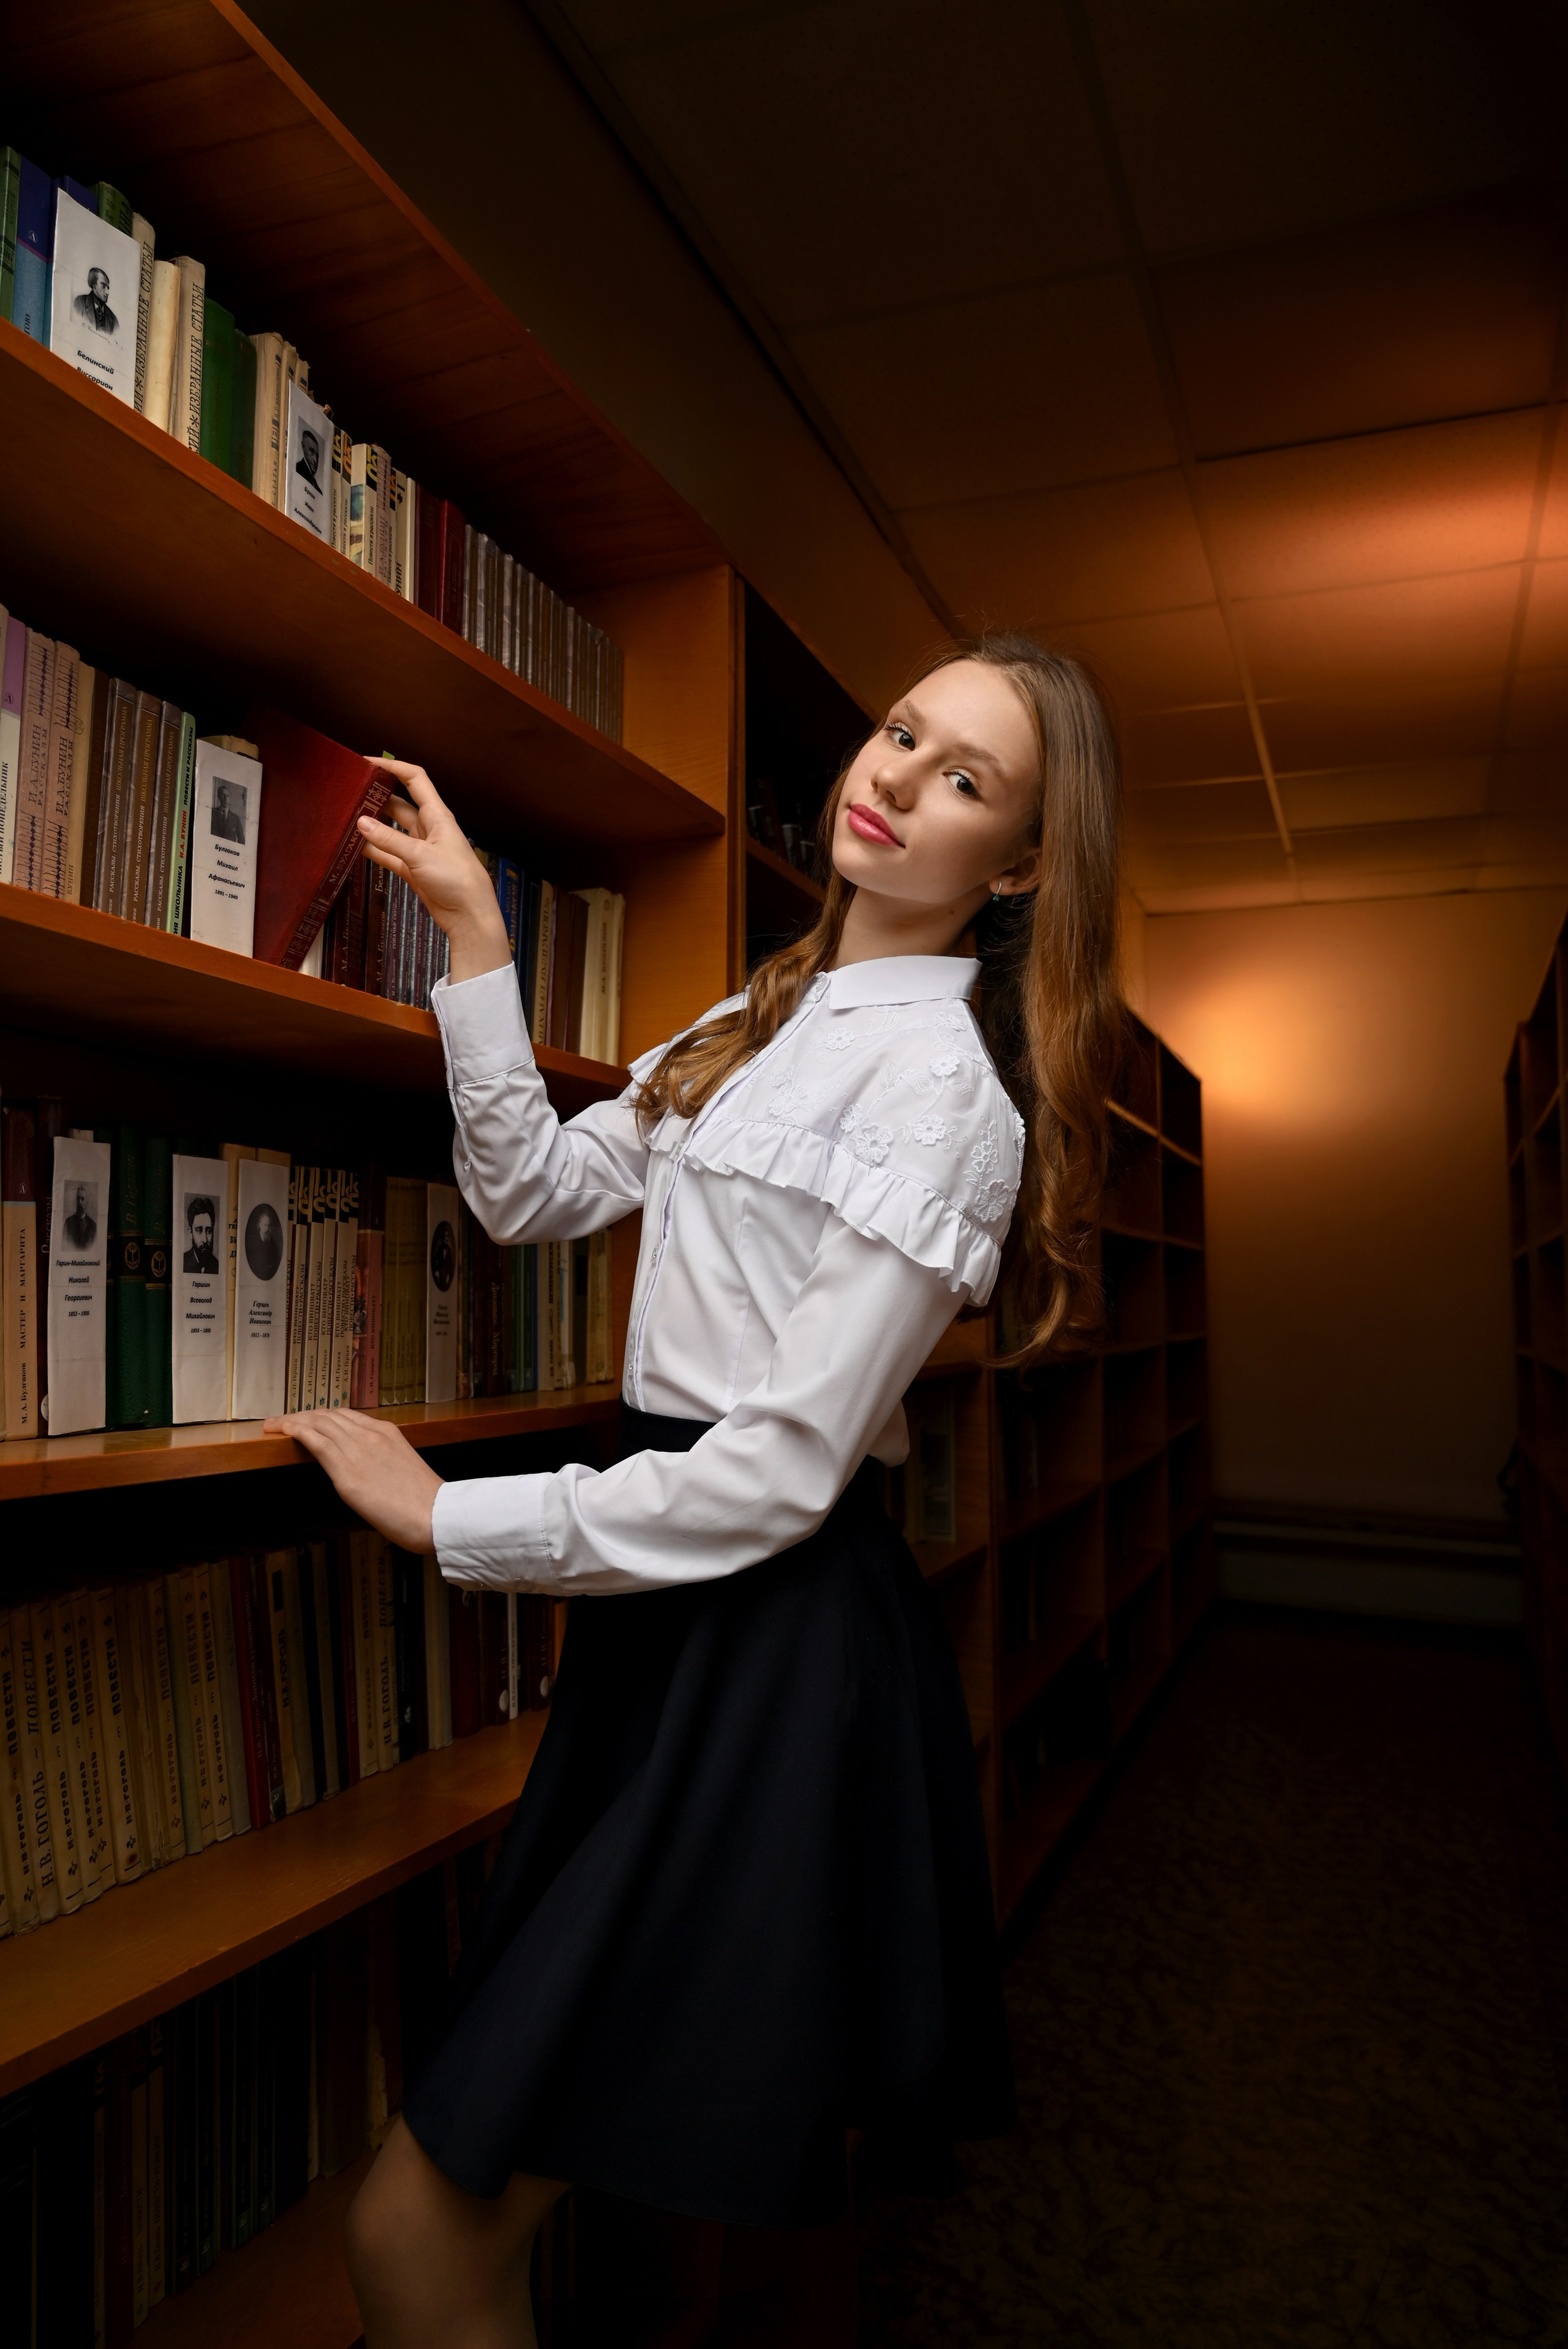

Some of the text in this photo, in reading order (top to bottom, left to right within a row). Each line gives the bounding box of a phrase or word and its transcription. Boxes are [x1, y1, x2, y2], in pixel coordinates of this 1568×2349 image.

[135, 242, 153, 379] ИЗБРАННЫЕ СТАТЬИ
[77, 350, 114, 375] Белинский
[188, 282, 204, 418] ИЗБРАННЫЕ СТАТЬИ
[304, 487, 315, 500] Бунин
[305, 501, 314, 513] Иван
[119, 706, 127, 748] ПРОГРАММА
[144, 719, 153, 761] ПРОГРАММА
[37, 729, 48, 807] РАССКАЗЫ
[64, 739, 74, 817] РАССКАЗЫ
[141, 761, 149, 802] ШКОЛЬНАЯ
[136, 805, 145, 862] СТИХОТВОРЕНИЯ
[215, 844, 240, 857] Булгаков
[217, 860, 238, 871] Михаил
[208, 873, 245, 889] Афанасьевич
[329, 872, 339, 884] М.
[375, 865, 383, 892] Белая
[378, 1556, 386, 1627] ПОВЕСТИ
[80, 1637, 94, 1716] ПОВЕСТИ
[107, 1638, 121, 1716] ПОВЕСТИ
[156, 1626, 171, 1701] ПОВЕСТИ
[185, 1612, 200, 1685] ПОВЕСТИ
[201, 1610, 216, 1682] ПОВЕСТИ
[2, 1670, 18, 1755] ПОВЕСТИ
[24, 1639, 40, 1735] ПОВЕСТИ
[45, 1652, 61, 1734] ПОВЕСТИ
[65, 1645, 81, 1725] ПОВЕСТИ
[380, 1656, 390, 1713] ГОГОЛЬ
[33, 1770, 50, 1847] ГОГОЛЬ
